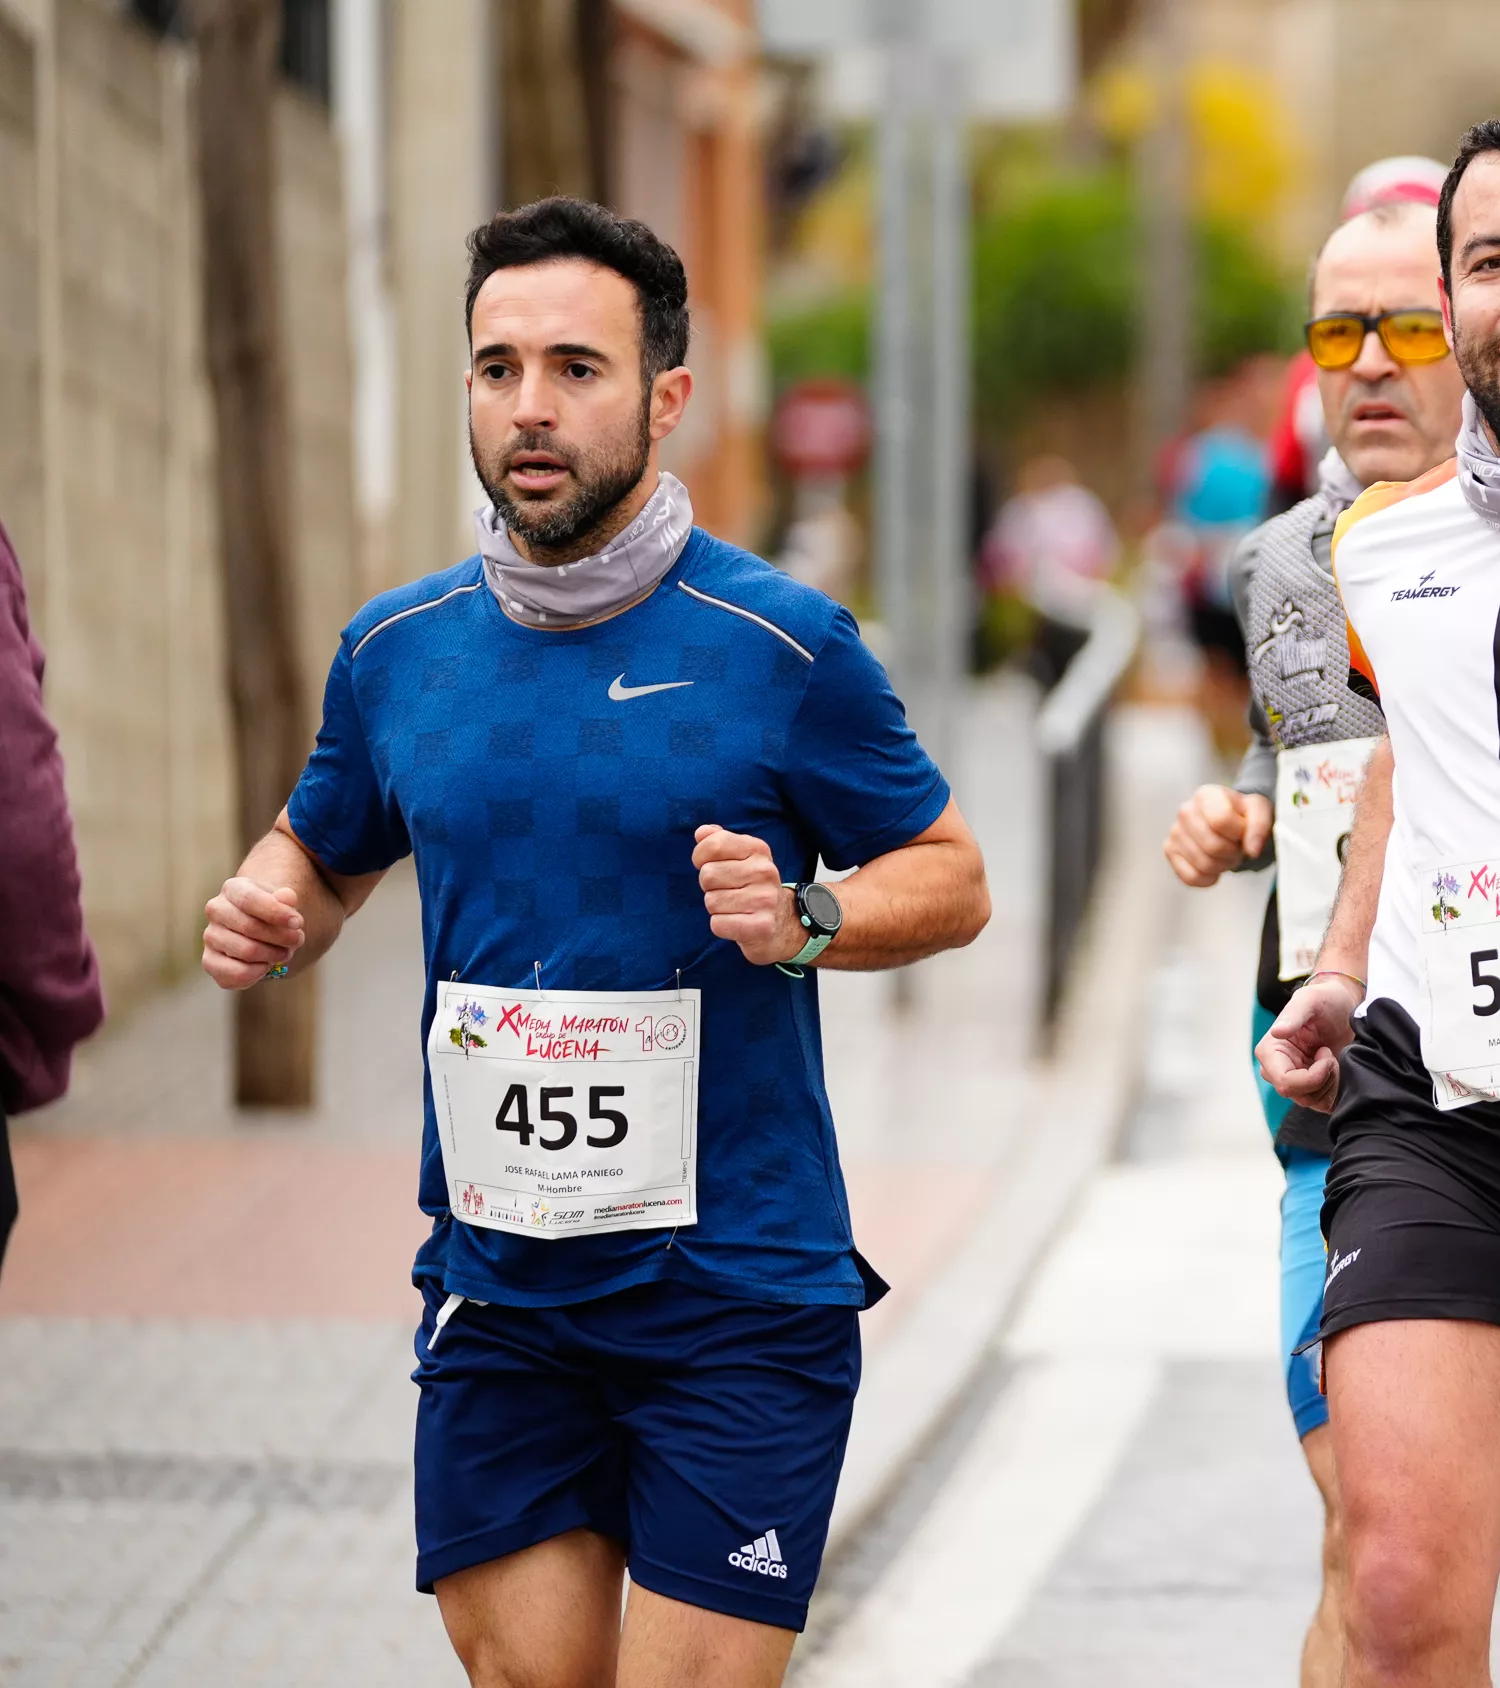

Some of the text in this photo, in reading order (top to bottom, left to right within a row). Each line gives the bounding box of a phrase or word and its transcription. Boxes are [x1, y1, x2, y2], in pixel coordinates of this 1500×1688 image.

[624, 519, 645, 545] Cars
[1390, 585, 1462, 603] TEAMERGY
[1468, 864, 1488, 901] X
[496, 1003, 630, 1039] X MEDIA MARATÓN
[526, 1033, 612, 1061] LUCENA
[495, 1083, 629, 1151] 455
[505, 1165, 624, 1181] JOSE RAFAEL LAMA PANIEGO
[537, 1184, 582, 1194] M-Hombre
[594, 1197, 683, 1215] mediamaratonlucena.com
[728, 1552, 788, 1580] adidas
